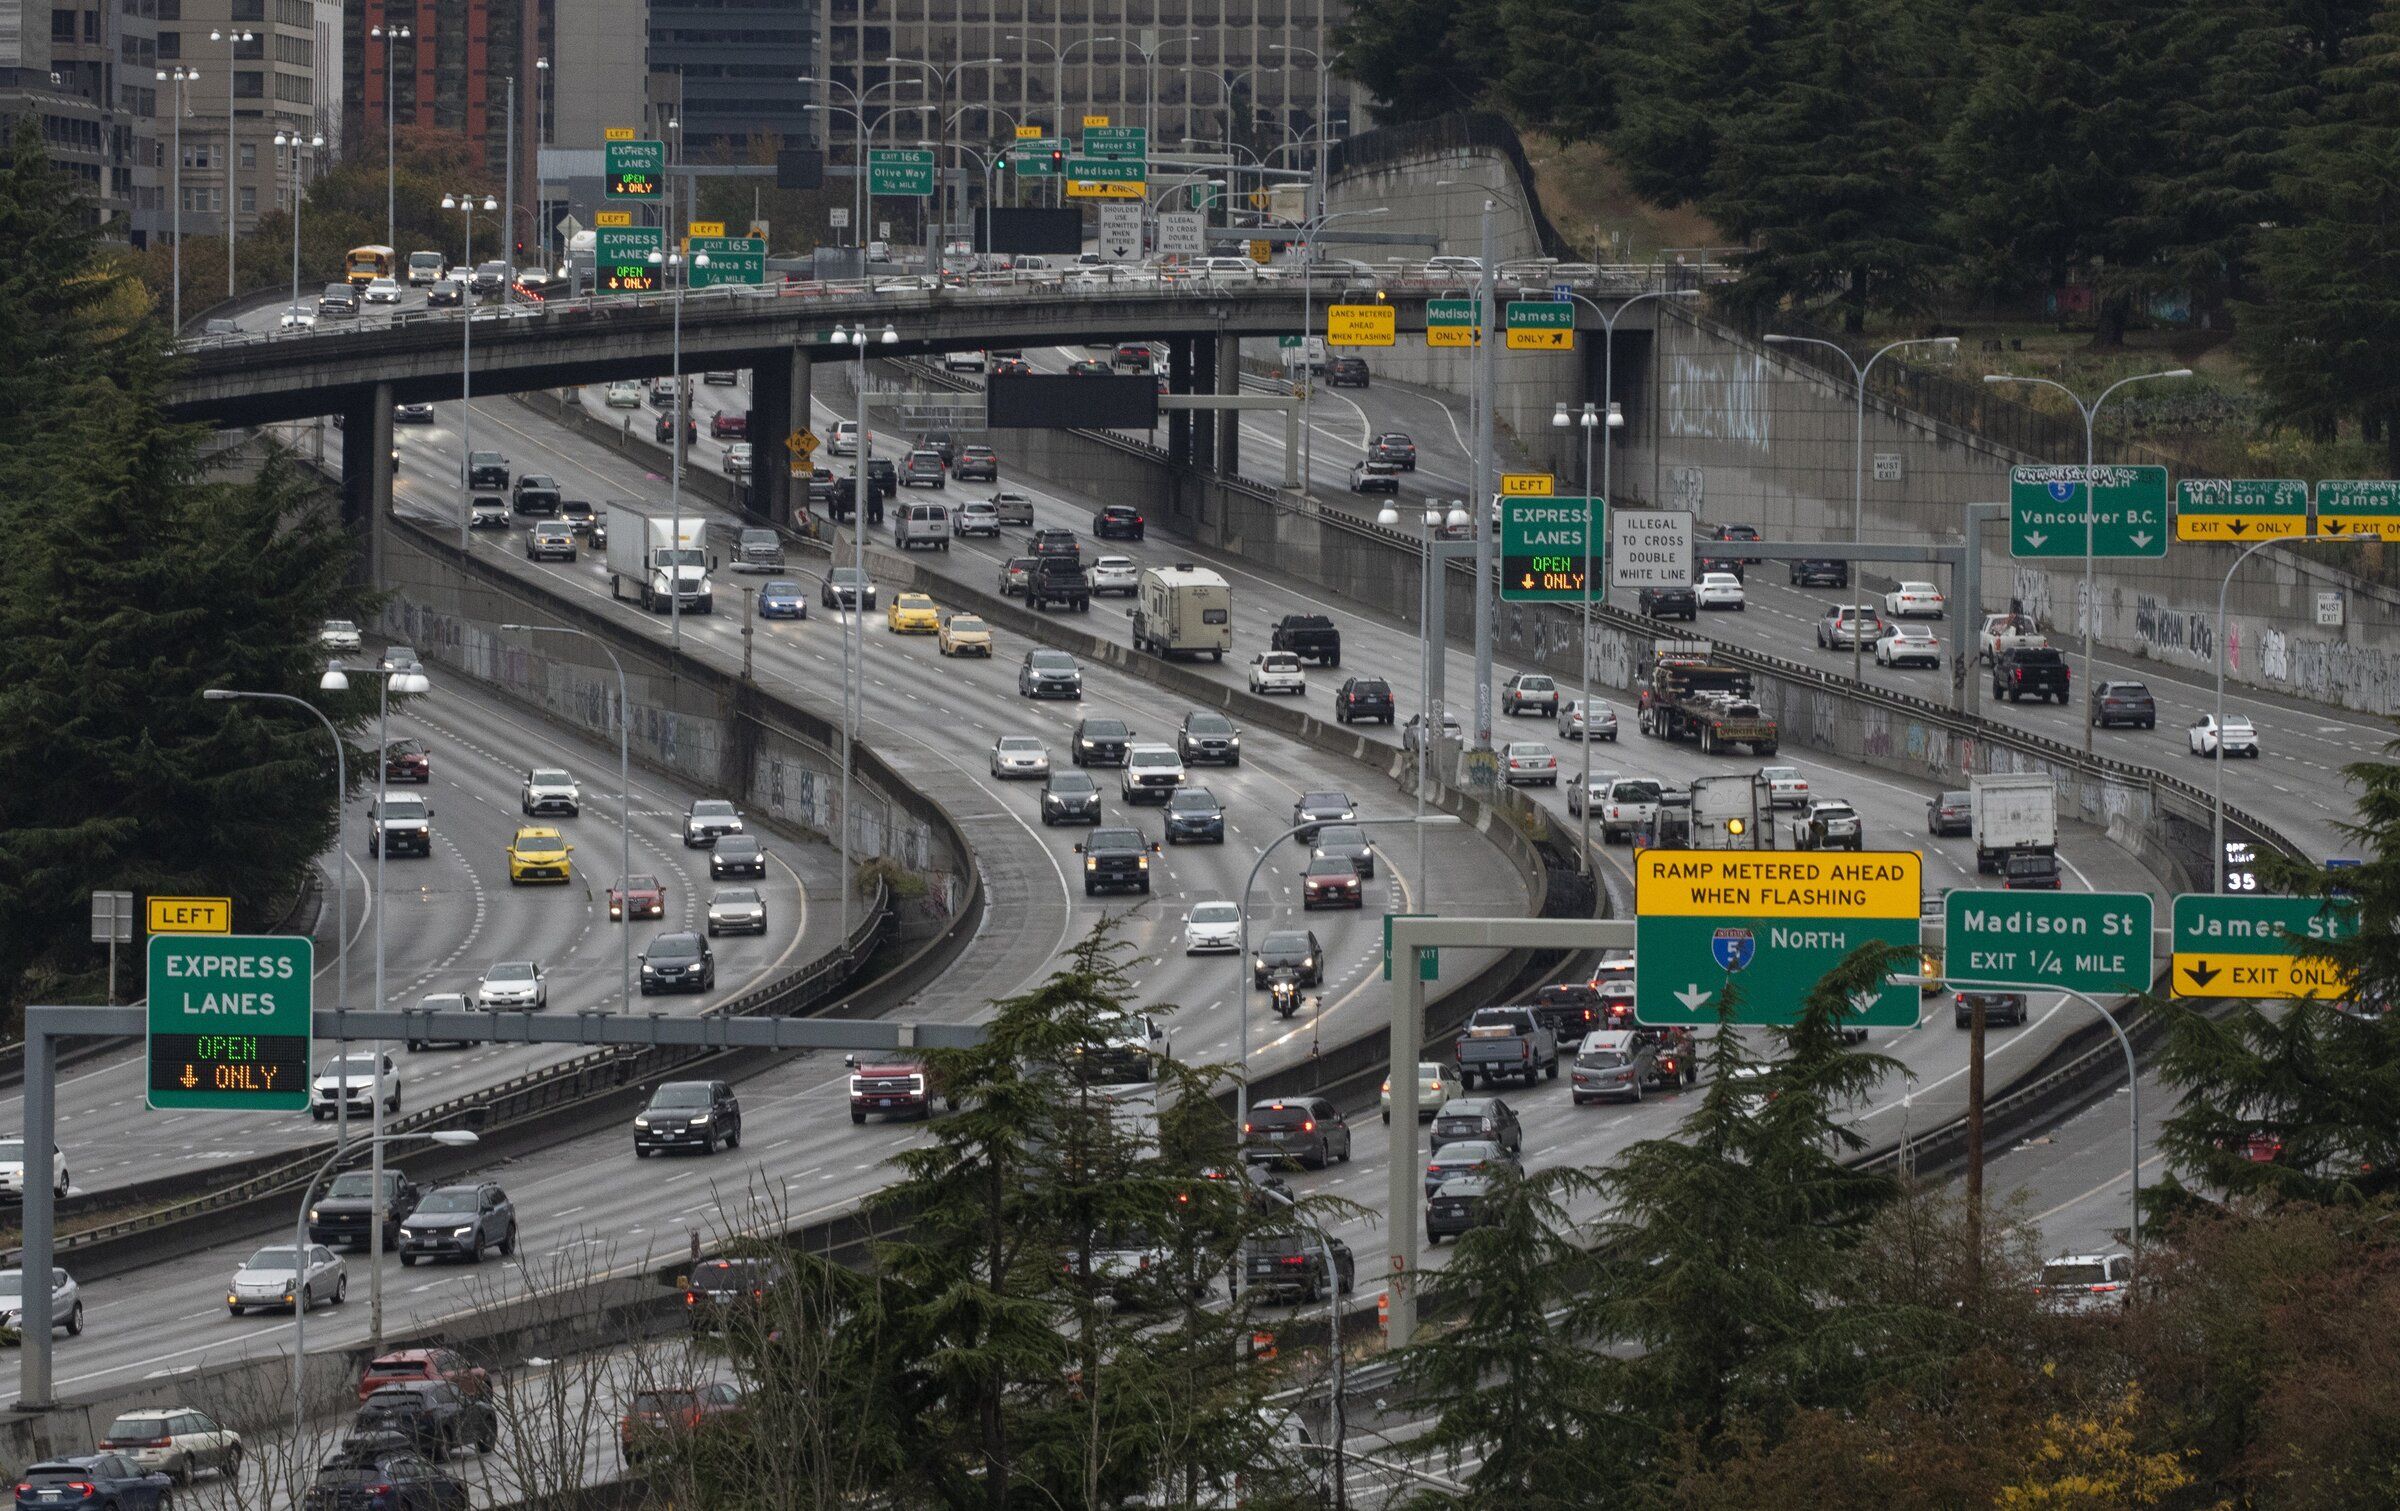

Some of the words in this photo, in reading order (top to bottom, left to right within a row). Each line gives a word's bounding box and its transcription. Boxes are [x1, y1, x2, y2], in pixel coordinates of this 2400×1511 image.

[1115, 129, 1131, 137] 167
[611, 146, 658, 156] EXPRESS
[1093, 142, 1124, 150] Mercer
[1126, 142, 1136, 150] St
[901, 152, 920, 161] 166
[617, 159, 651, 168] LANES
[874, 169, 901, 178] Olive
[905, 169, 926, 179] Way
[1075, 166, 1121, 176] Madison
[1125, 167, 1138, 176] St
[622, 174, 645, 184] OPEN
[629, 183, 653, 194] ONLY
[602, 215, 625, 223] LEFT
[603, 234, 658, 245] EXPRESS
[704, 241, 722, 249] EXIT
[728, 240, 750, 251] 165
[610, 250, 650, 259] LANES
[696, 260, 740, 270] eneca
[744, 260, 758, 270] St
[616, 266, 643, 277] OPEN
[624, 277, 652, 289] ONLY
[725, 275, 746, 283] MILE
[1330, 310, 1356, 318] LANES
[1359, 310, 1393, 318] METERED
[1429, 307, 1477, 320] Madison
[1510, 310, 1556, 322] James
[1559, 312, 1571, 322] St
[1332, 333, 1353, 341] WHEN
[1355, 333, 1392, 341] FLASHING
[1436, 332, 1464, 341] ONLY
[1517, 334, 1544, 343] ONLY
[1877, 462, 1898, 470] MUST
[1879, 471, 1896, 479] EXIT
[1510, 480, 1544, 491] LEFT
[2057, 483, 2066, 496] 5
[2191, 491, 2265, 505] Madison
[2274, 491, 2294, 505] St
[2330, 492, 2388, 506] James
[1513, 508, 1593, 523] EXPRESS
[2021, 510, 2120, 524] Vancouver
[2127, 510, 2157, 524] B.C.
[1628, 518, 1677, 529] ILLEGAL
[2191, 522, 2219, 532] EXIT
[2256, 522, 2291, 533] ONLY
[2353, 523, 2380, 534] EXIT
[1523, 531, 1582, 545] LANES
[1622, 536, 1636, 546] TO
[1645, 536, 1684, 546] CROSS
[1629, 553, 1675, 563] DOUBLE
[1533, 556, 1571, 572] OPEN
[1620, 569, 1653, 580] WHITE
[1661, 569, 1686, 580] LINE
[1544, 573, 1584, 589] ONLY
[2320, 603, 2339, 612] MUST
[2322, 613, 2337, 622] EXIT
[1653, 863, 1713, 879] RAMP
[1722, 863, 1819, 880] METERED
[1830, 865, 1904, 881] AHEAD
[2228, 873, 2256, 890] 35
[1691, 888, 1750, 904] WHEN
[1761, 889, 1866, 905] FLASHING
[162, 908, 215, 924] LEFT
[1964, 910, 2087, 935] Madison
[2102, 913, 2133, 936] St
[2188, 914, 2286, 938] James
[2307, 916, 2338, 938] St
[1771, 927, 1845, 949] NORTH
[1727, 941, 1740, 962] 5
[166, 955, 294, 979] EXPRESS
[1970, 952, 2017, 970] EXIT
[2075, 954, 2126, 973] MILE
[2233, 967, 2279, 984] EXIT
[184, 992, 276, 1015] LANES
[198, 1035, 257, 1060] OPEN
[215, 1064, 278, 1090] ONLY
